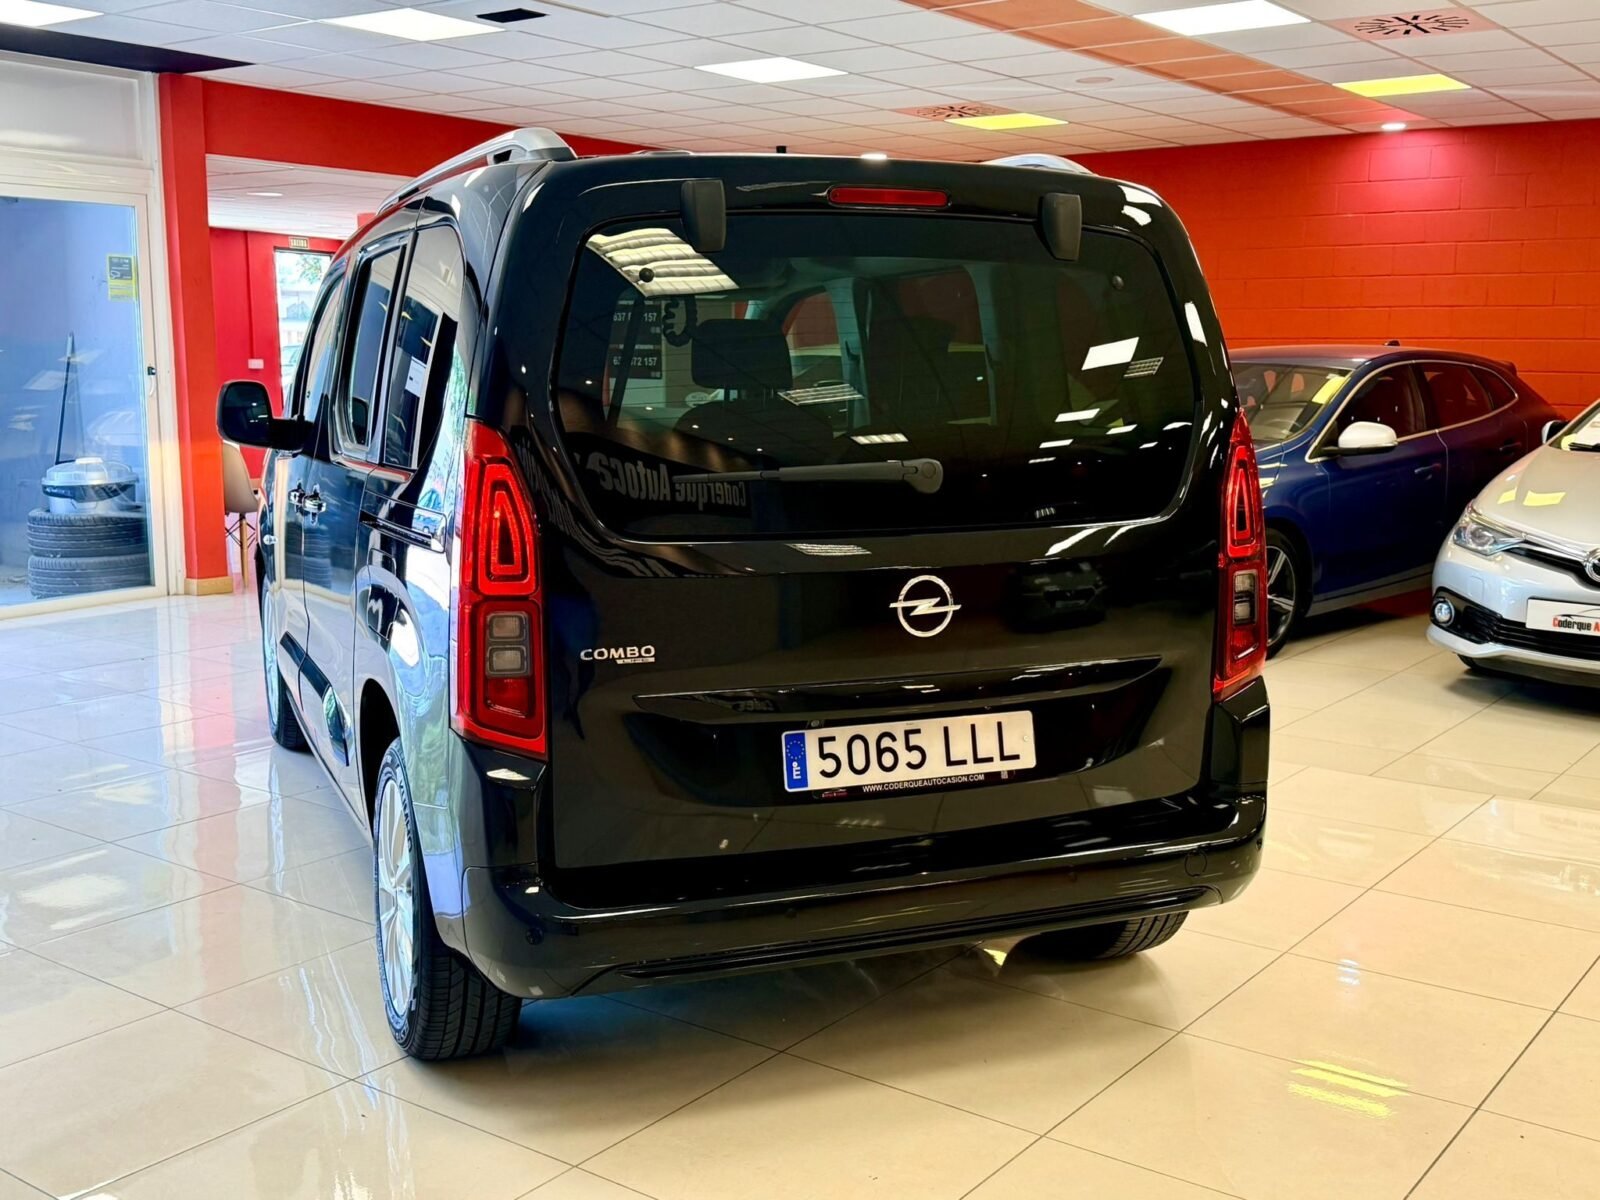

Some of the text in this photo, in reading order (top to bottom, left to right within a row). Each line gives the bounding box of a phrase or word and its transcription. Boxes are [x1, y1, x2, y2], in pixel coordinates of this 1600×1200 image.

[643, 312, 657, 321] 157
[643, 356, 657, 366] 157
[1553, 617, 1592, 631] Coderque
[580, 644, 655, 660] COMBO
[817, 721, 1021, 778] 5065 LLL
[792, 766, 802, 779] E
[862, 773, 985, 793] WWW.CODERQUEAUTOCASION.COM
